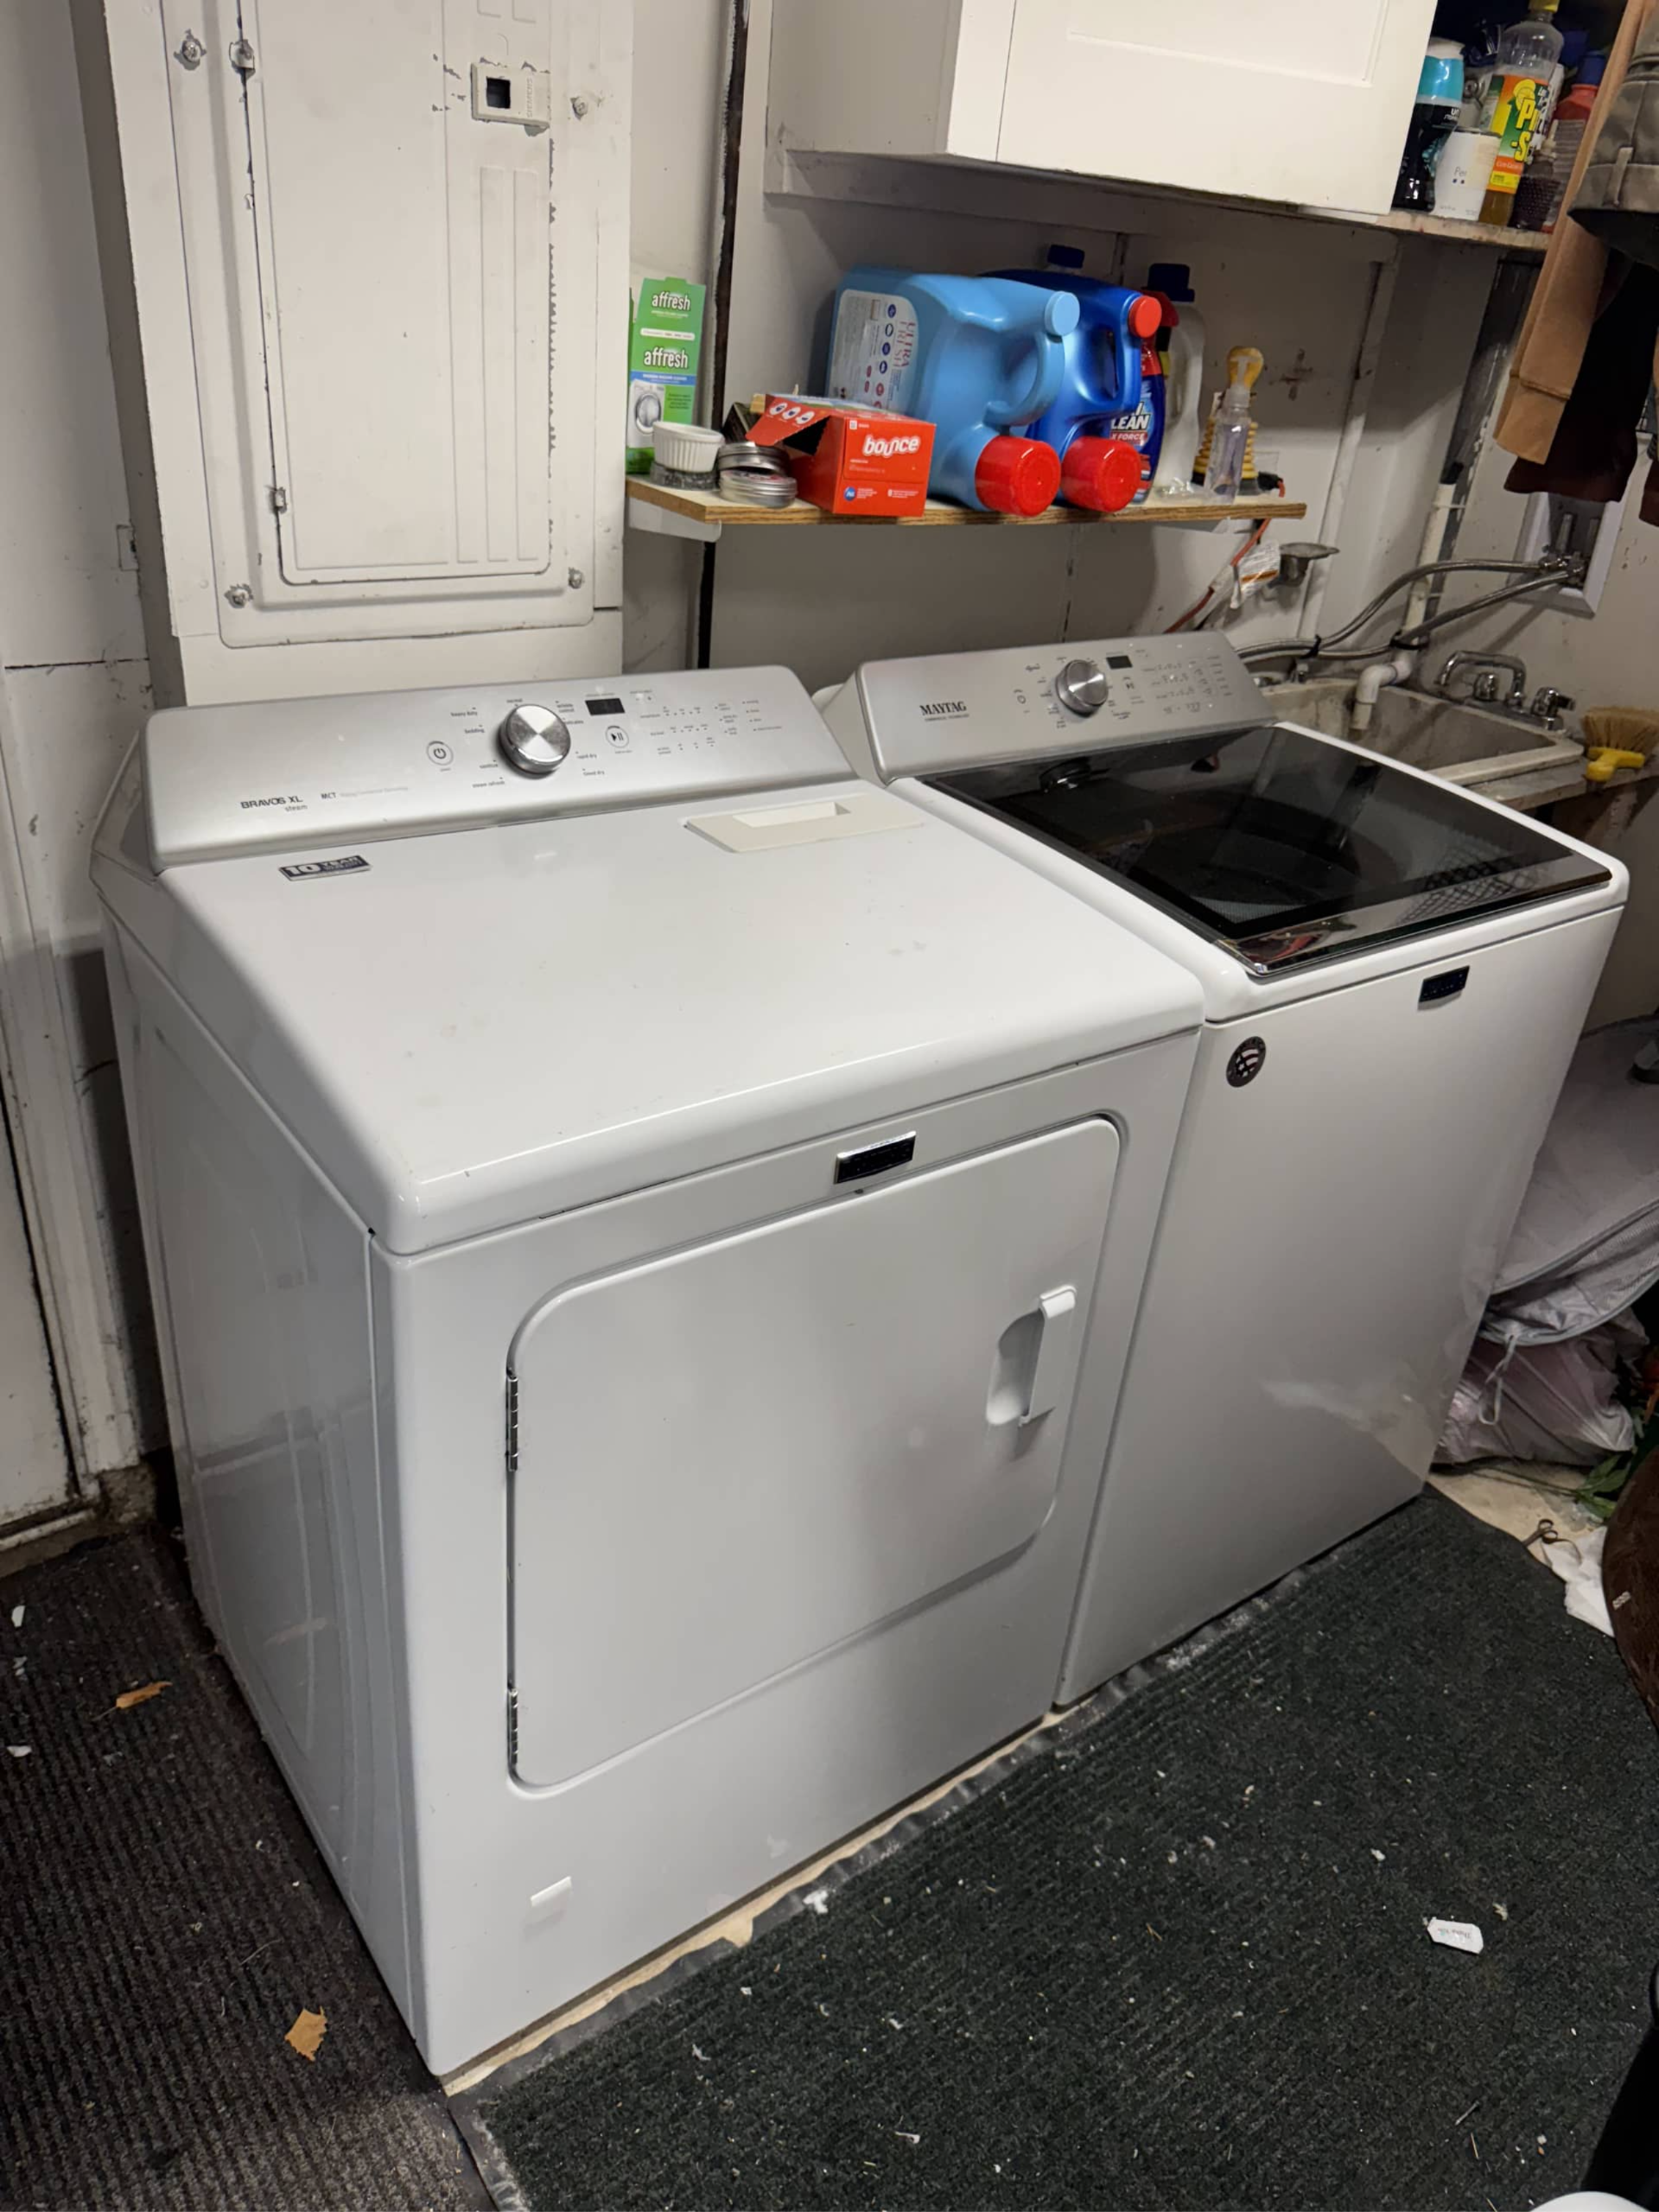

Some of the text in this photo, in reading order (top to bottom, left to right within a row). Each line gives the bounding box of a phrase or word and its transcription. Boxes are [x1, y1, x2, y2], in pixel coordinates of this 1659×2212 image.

[652, 291, 691, 311] affresh
[644, 346, 689, 369] affresh
[1109, 414, 1151, 430] LEAN
[862, 434, 921, 459] bounce
[919, 701, 968, 716] MAYTAG
[240, 795, 304, 810] BRAVOS XL
[321, 791, 337, 800] MCT
[284, 804, 308, 812] steam
[284, 864, 321, 875] 10
